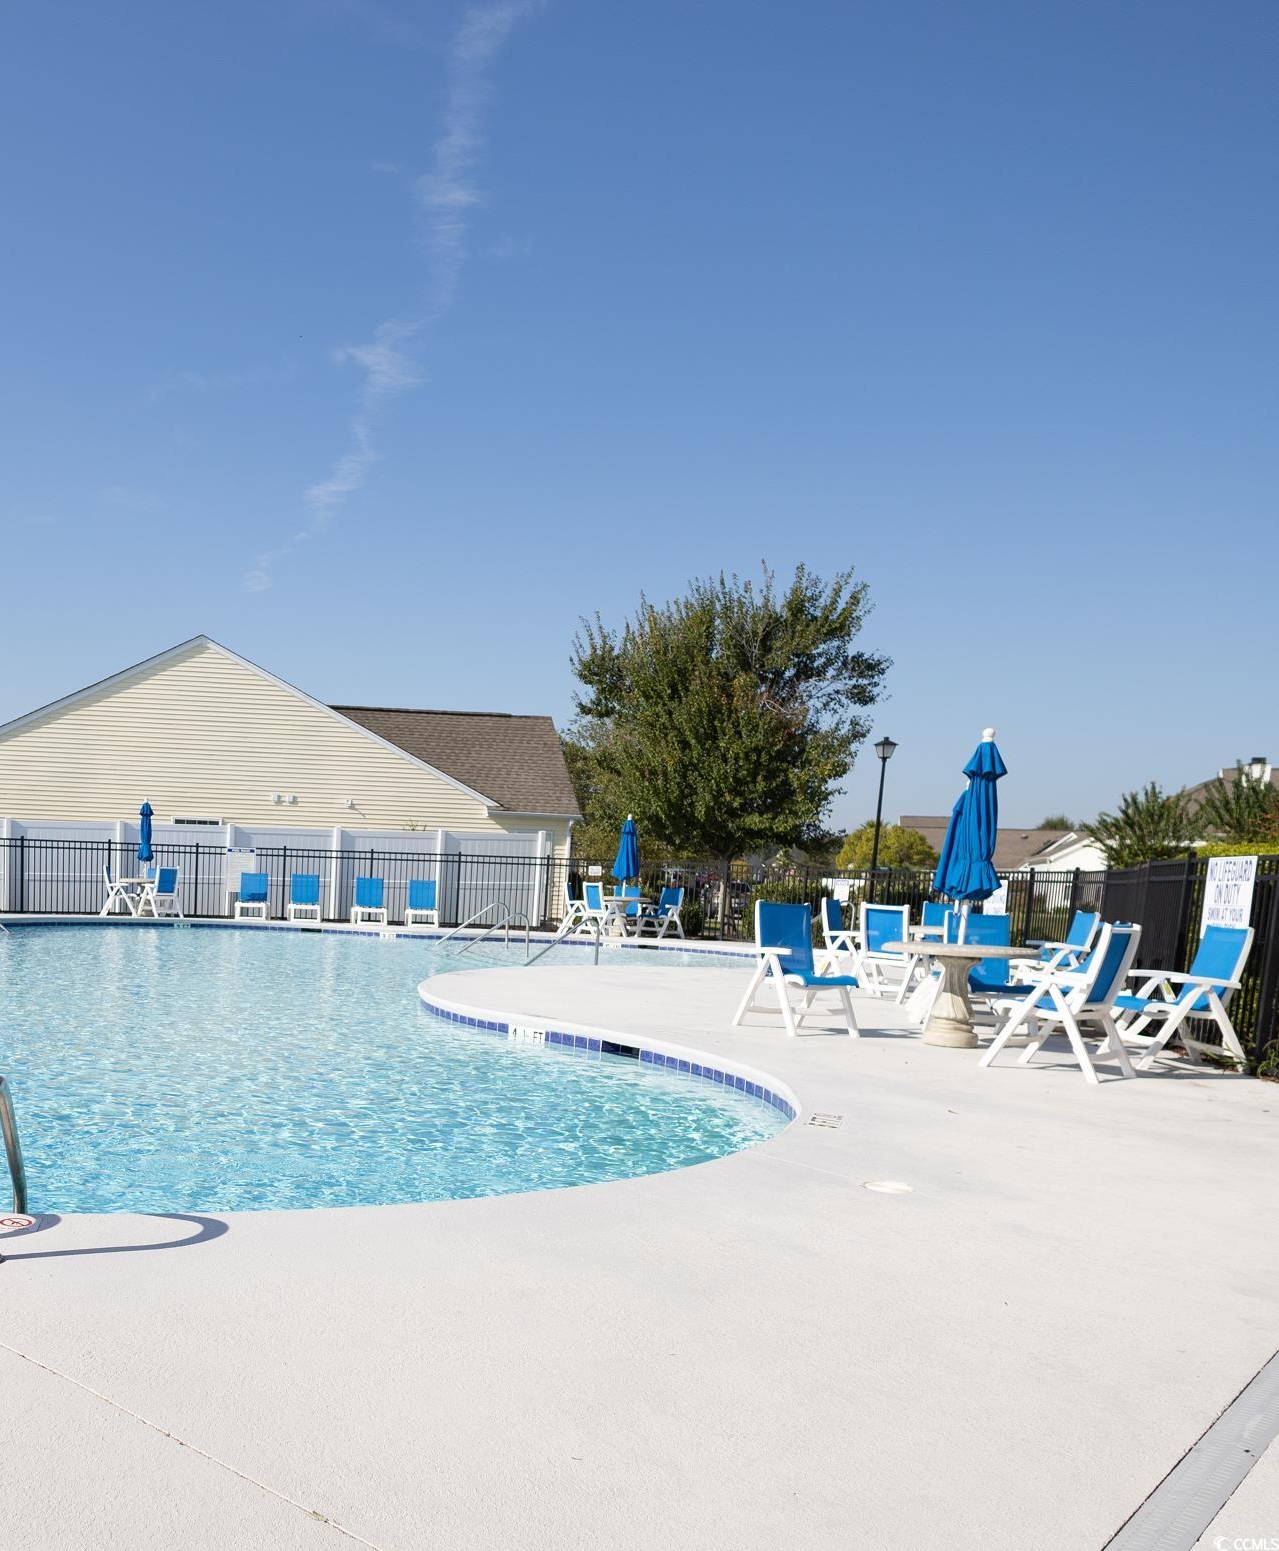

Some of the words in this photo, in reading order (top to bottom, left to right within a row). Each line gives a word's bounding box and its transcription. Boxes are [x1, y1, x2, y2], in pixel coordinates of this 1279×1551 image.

[1209, 861, 1219, 882] NO
[1218, 860, 1253, 882] LIFEGUARD
[1214, 883, 1223, 904] ON
[1223, 883, 1242, 905] DUTY
[1207, 907, 1221, 921] SWIM
[1221, 907, 1229, 921] AT
[1229, 907, 1244, 923] YOUR
[533, 1031, 544, 1044] FT
